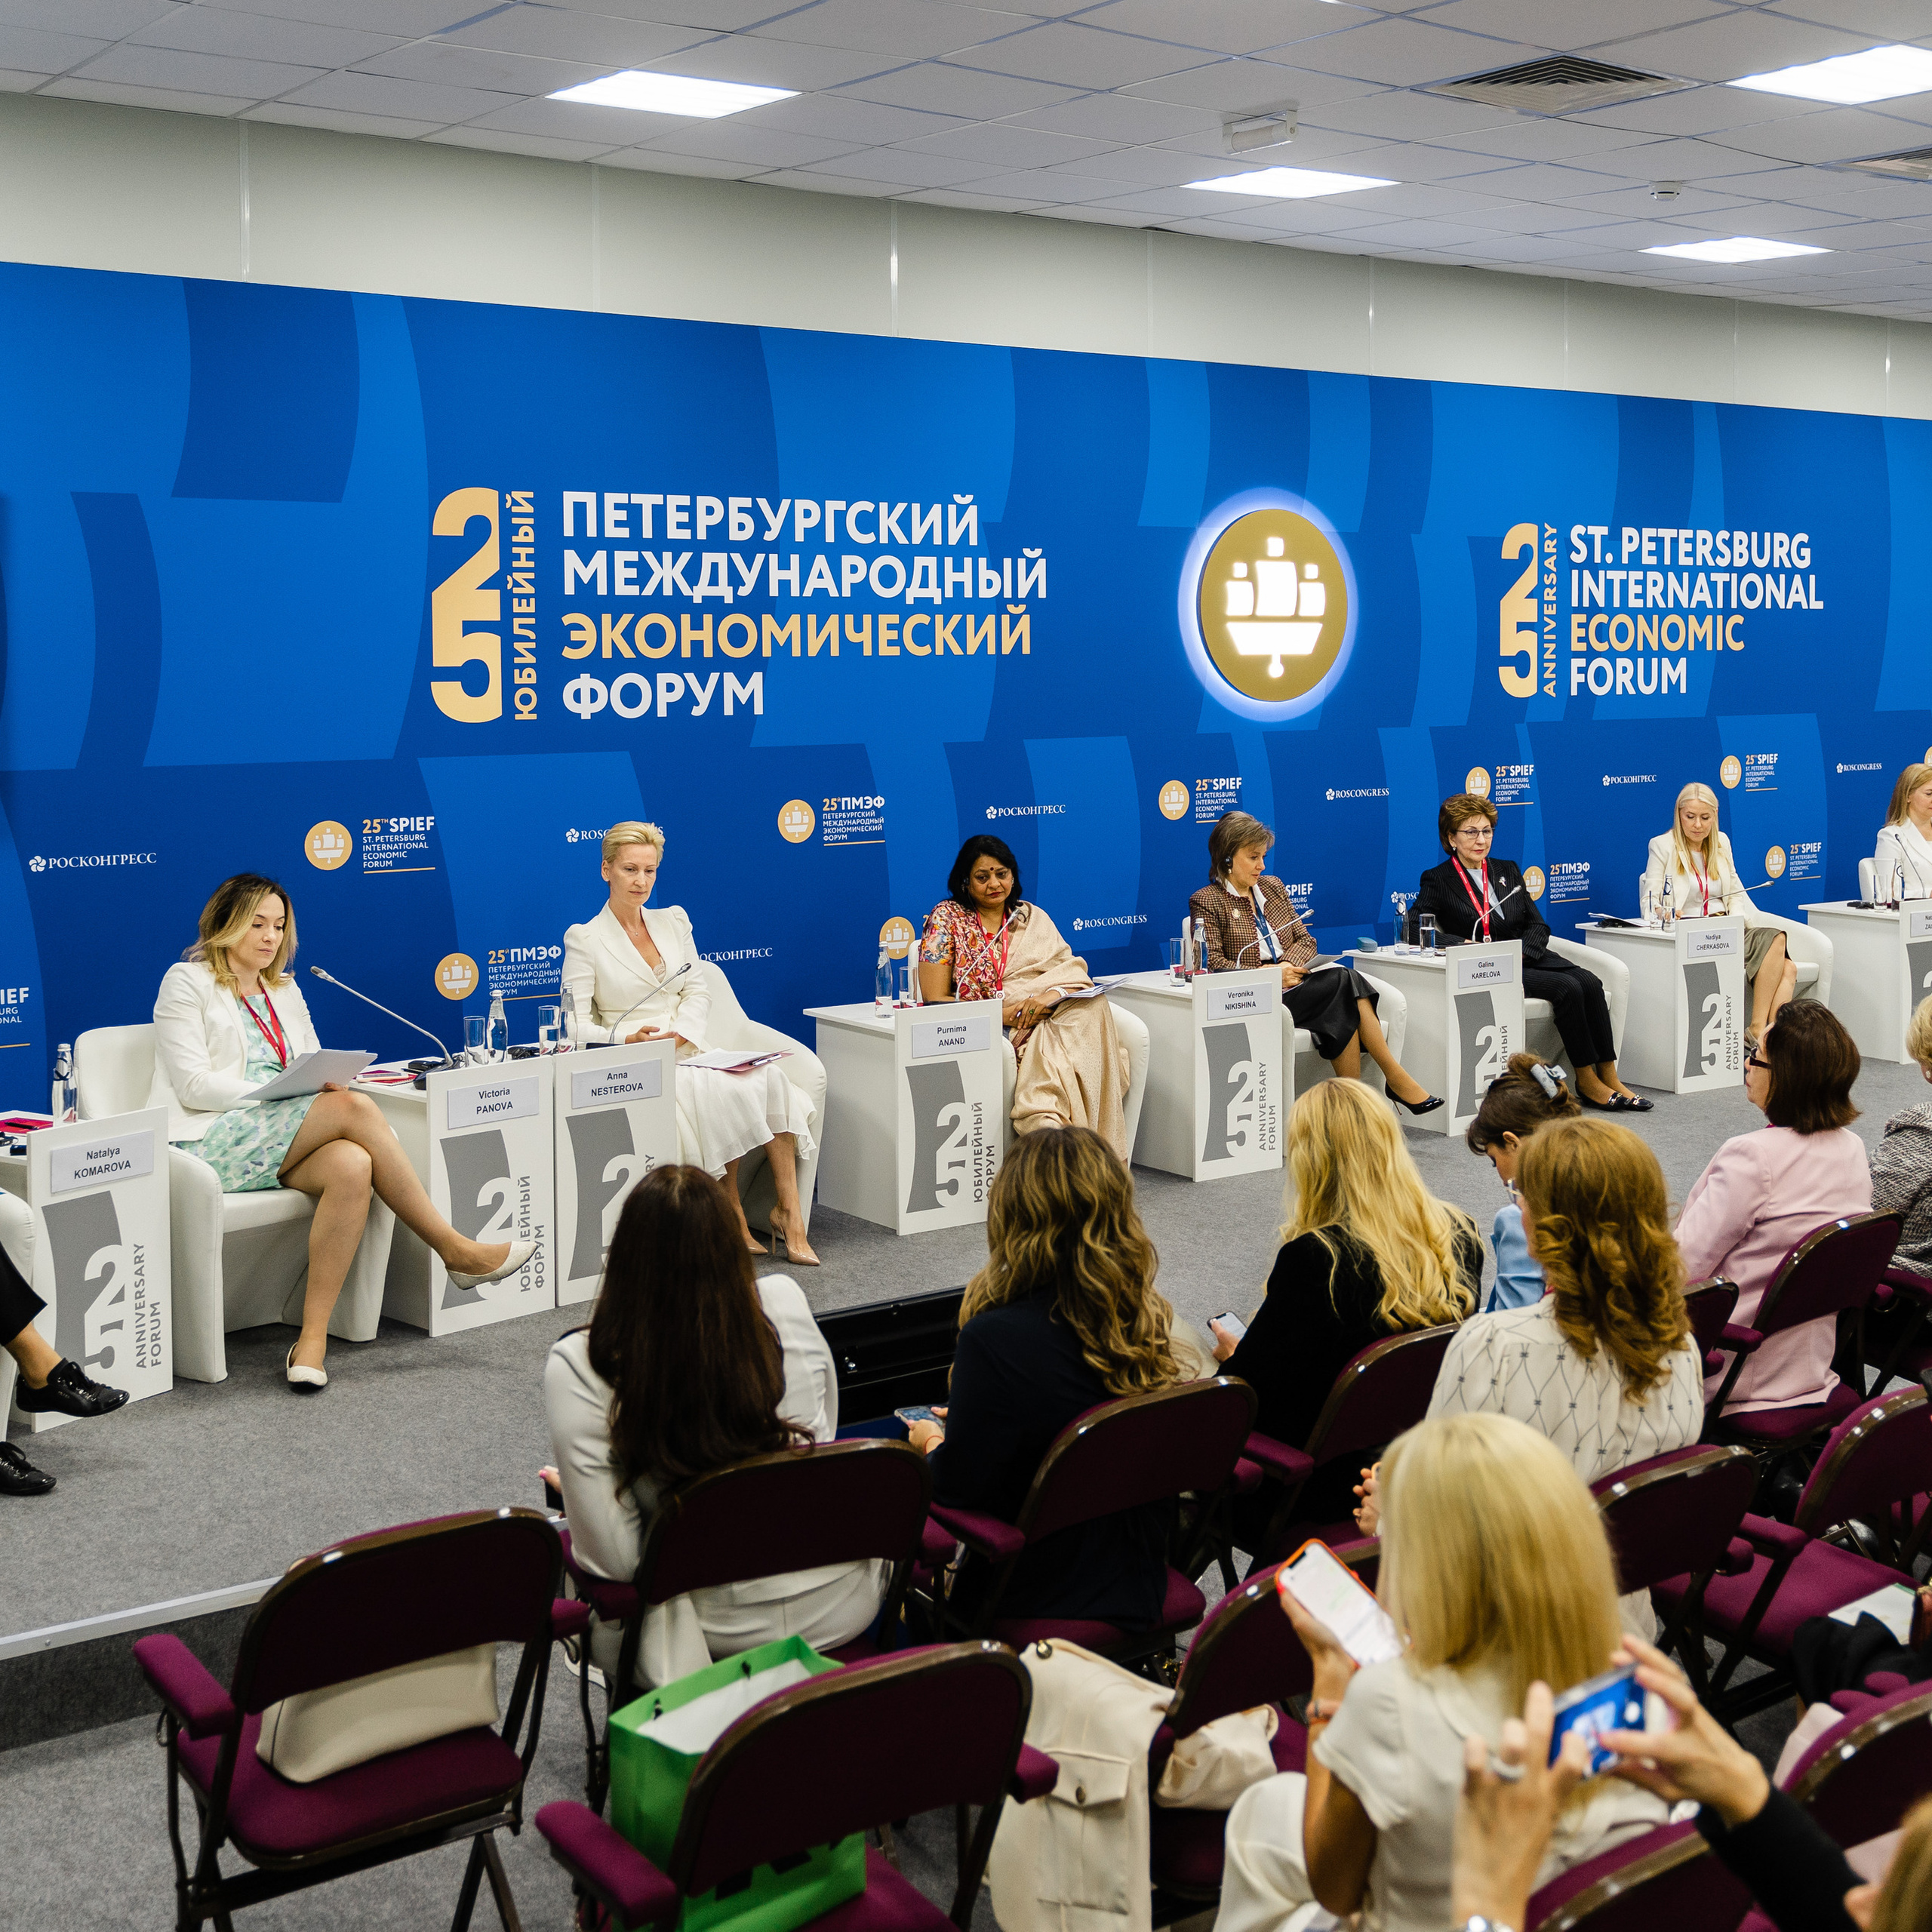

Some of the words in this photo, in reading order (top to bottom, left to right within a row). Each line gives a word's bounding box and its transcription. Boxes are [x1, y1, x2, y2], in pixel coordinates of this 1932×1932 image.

[562, 491, 979, 546] ПЕТЕРБУРГСКИЙ
[1570, 524, 1614, 565] ST.
[1621, 527, 1811, 569] PETERSBURG
[563, 548, 1048, 605] МЕЖДУНАРОДНЫЙ
[1571, 569, 1824, 610] INTERNATIONAL
[430, 487, 503, 724] 25
[506, 491, 537, 721] ЮБИЛЕЙНЫЙ
[1498, 522, 1539, 698] 25
[1543, 522, 1558, 698] ANNIVERSARY
[561, 605, 1032, 660] ЭКОНОМИЧЕСКИЙ
[1571, 614, 1745, 652] ECONOMIC
[1570, 657, 1687, 696] FORUM
[561, 671, 764, 720] ФОРУМ
[1758, 753, 1778, 764] SPIEF
[1510, 764, 1534, 776] SPIEF
[1844, 763, 1882, 772] ROSCONGRESS
[1213, 777, 1242, 790] SPIEF
[1611, 774, 1657, 784] РОСКОНГРЕСС
[1335, 788, 1389, 798] ROSCONGRESS
[841, 795, 885, 811] ПМЭФ
[823, 810, 875, 820] ПЕТЕРБУРГСКИЙ
[998, 804, 1066, 817] РОСКОНГРЕСС
[389, 816, 435, 832] SPIEF
[823, 817, 884, 826] МЕЖДУНАРОДНЫЙ
[823, 824, 882, 834] ЭКОНОМИЧЕСКИЙ
[375, 833, 426, 843] PETERSBURG
[362, 841, 429, 851] INTERNATIONAL
[1801, 842, 1822, 854] SPIEF
[48, 852, 157, 869] РОСКОНГРЕСС
[363, 851, 408, 860] ECONOMIC
[1562, 862, 1590, 874] ПМЭФ
[1285, 883, 1313, 897] SPIEF
[1084, 914, 1148, 928] ROSCONGRESS
[510, 945, 562, 962] ПМЭФ
[700, 947, 773, 961] ОСКОНГРЕСС
[1696, 943, 1730, 951] CHERKASOVA
[488, 961, 550, 973] ПЕТЕРБУРГСКИЙ
[488, 968, 561, 981] МЕЖДУНАРОДНЫЙ
[1472, 971, 1501, 980] KARELOVA
[489, 976, 559, 989] ЭКОНОМИЧЕСКИЙ
[0, 987, 29, 1004] IEF
[1227, 990, 1254, 999] Veronika
[1225, 1001, 1257, 1011] NIKISHINA
[937, 1025, 967, 1035] Purnima
[938, 1037, 965, 1047] ANAND
[1500, 1025, 1508, 1070] ЕЙНЫЙ
[607, 1071, 628, 1081] Anna
[478, 1087, 510, 1100] Victoria
[591, 1082, 644, 1097] NESTEROVA
[476, 1101, 513, 1115] PANOVA
[1226, 1060, 1254, 1157] 25
[87, 1146, 121, 1161] Natalya
[935, 1102, 968, 1208] 25
[971, 1102, 983, 1203] ЮБИЛЕЙНЫЙ
[74, 1160, 131, 1180] KOMAROVA
[517, 1176, 531, 1292] ЮБЕЙНЫЙ
[534, 1225, 545, 1288] ФОРУМ
[134, 1244, 146, 1368] ANNIVERSARY
[150, 1301, 162, 1367] FORUM
